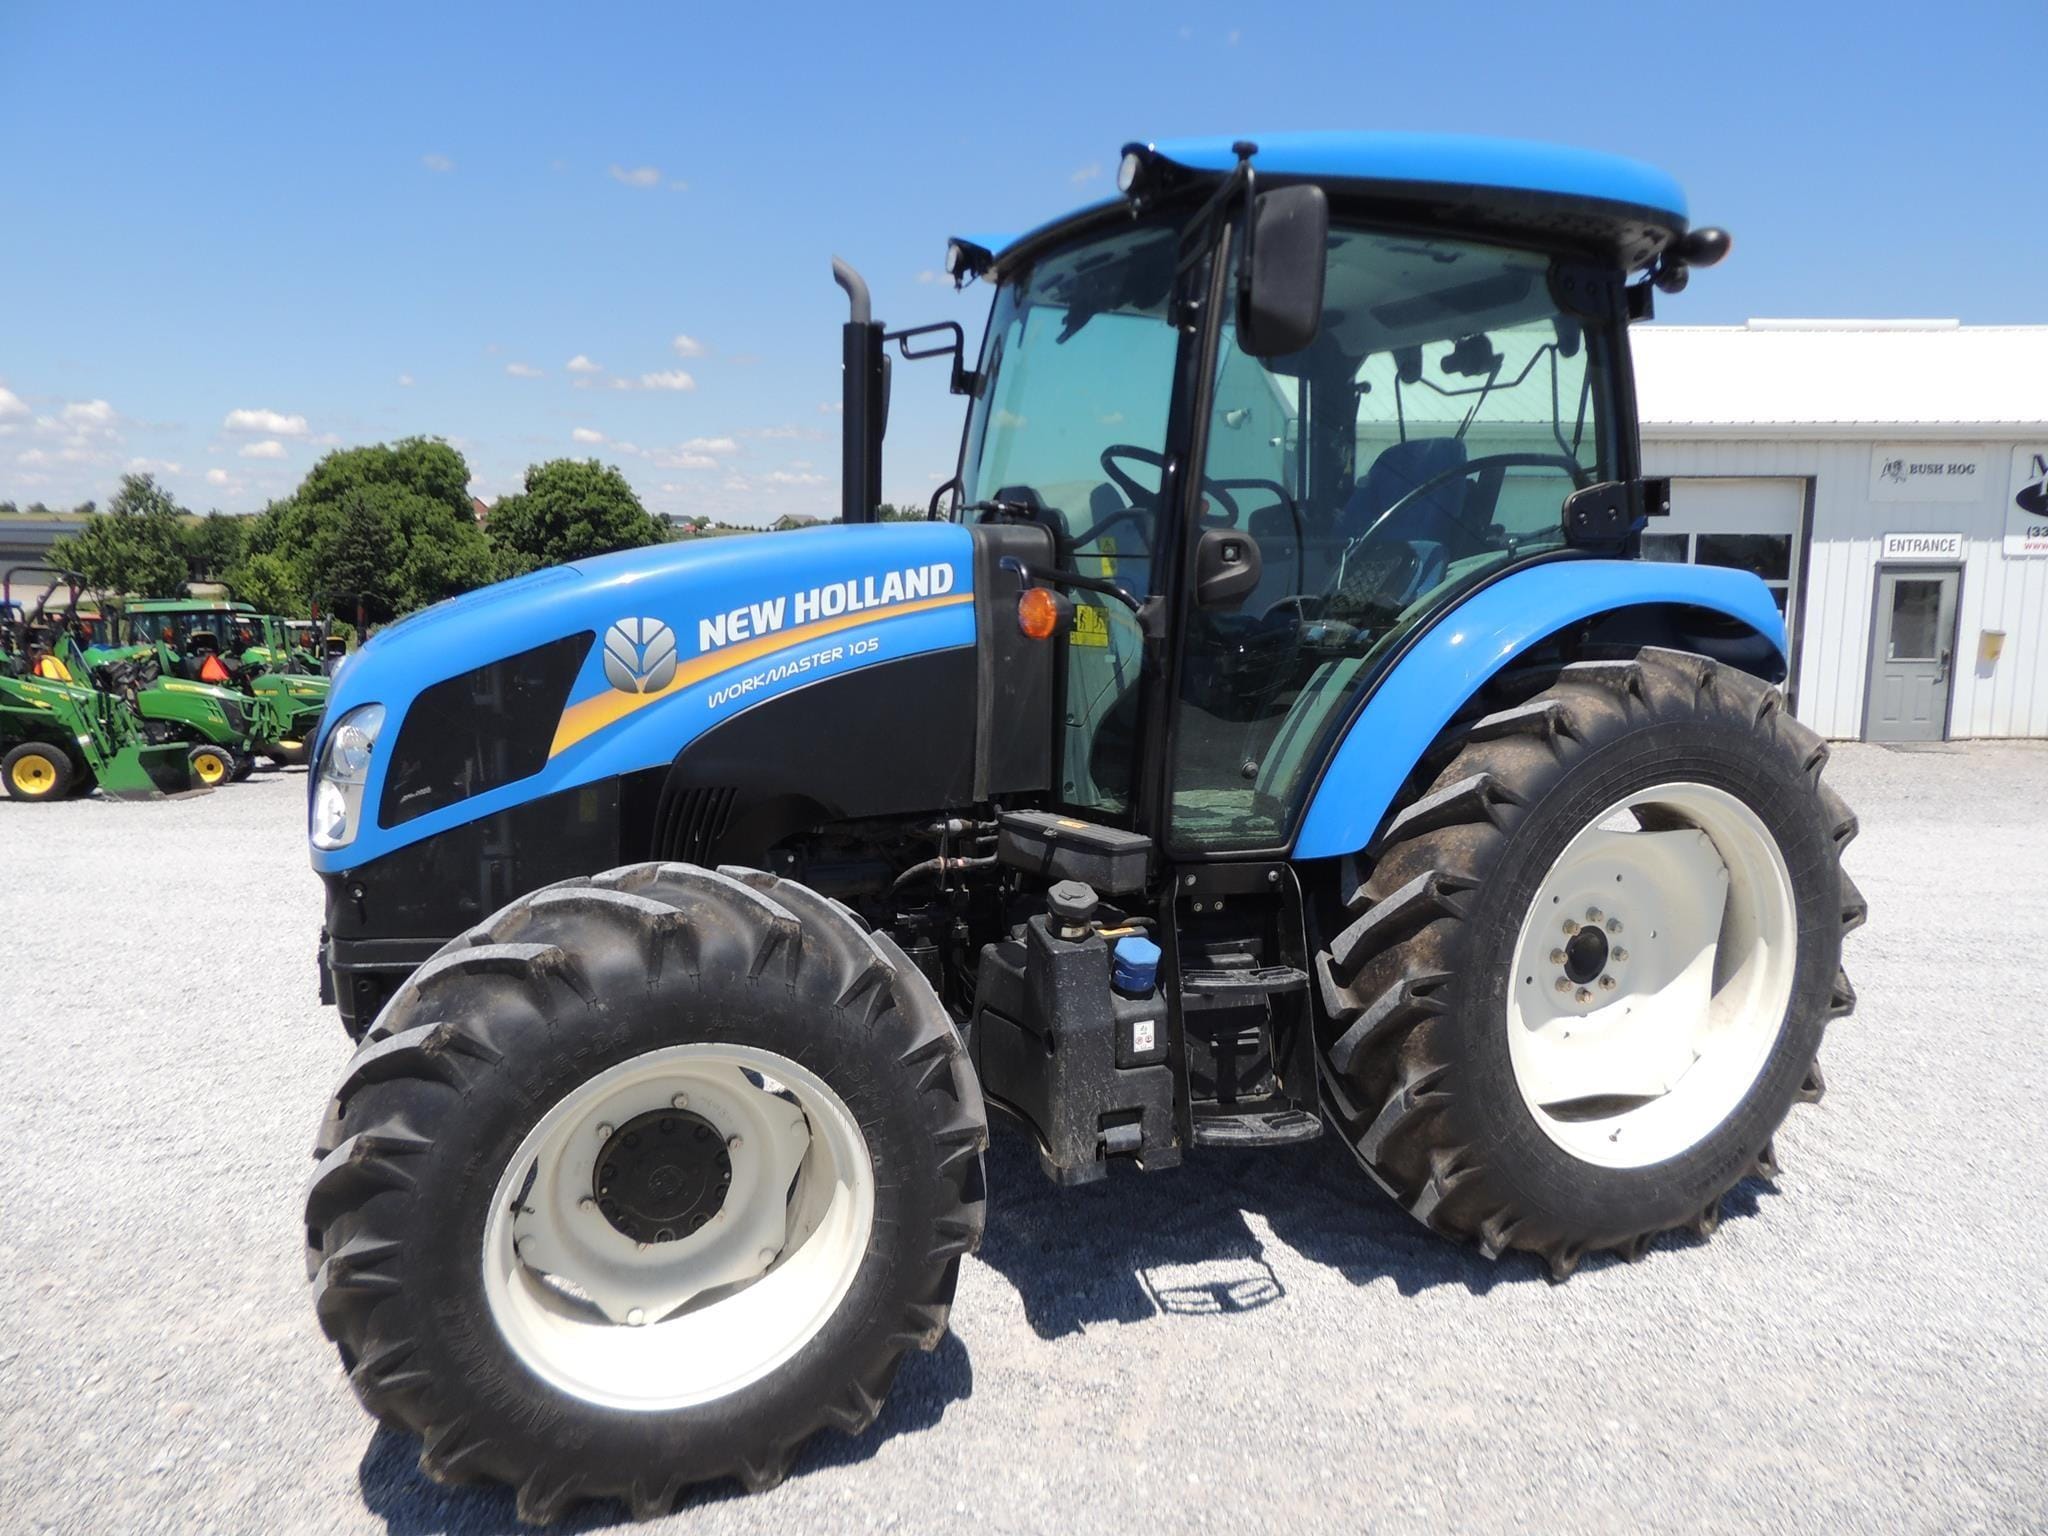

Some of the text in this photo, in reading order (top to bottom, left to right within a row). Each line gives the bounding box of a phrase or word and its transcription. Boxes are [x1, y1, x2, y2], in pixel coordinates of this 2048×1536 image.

[1909, 463, 1976, 475] BUSH HOG
[1889, 538, 1956, 552] ENTRANCE
[699, 562, 955, 651] NEW HOLLAND
[708, 637, 879, 709] WORKMASTER 105
